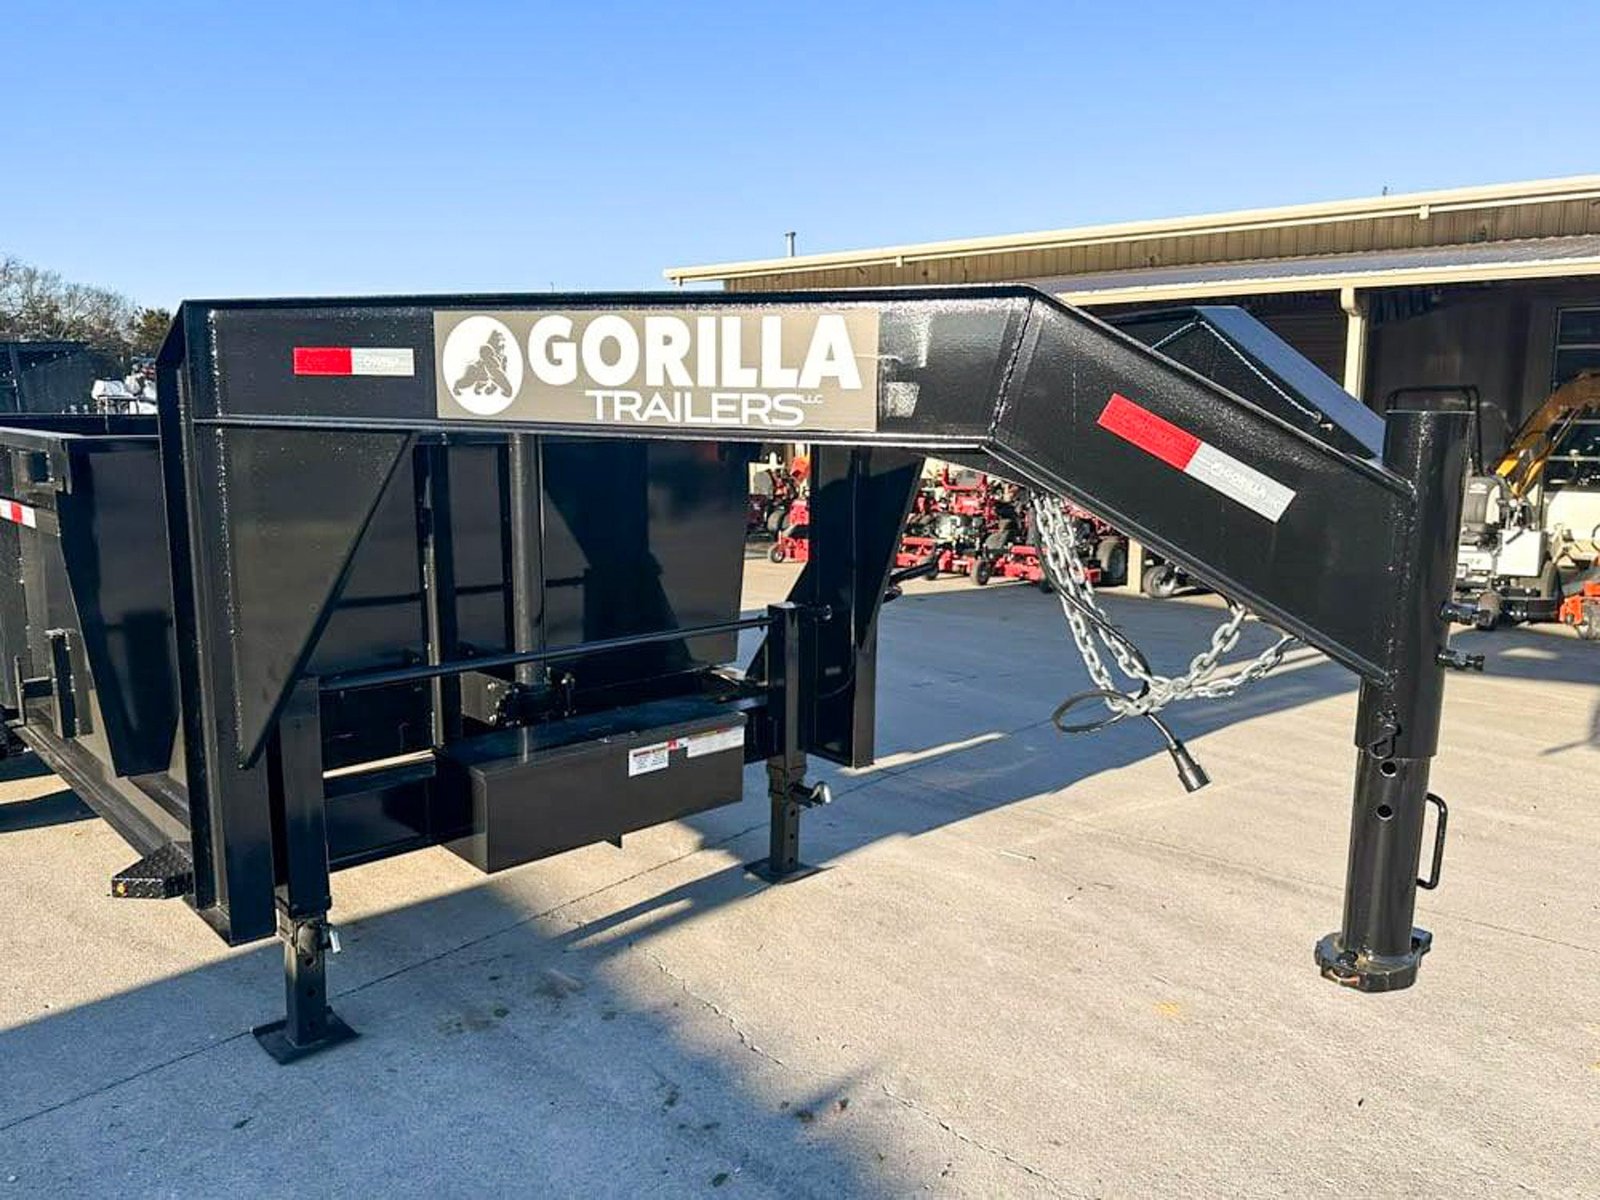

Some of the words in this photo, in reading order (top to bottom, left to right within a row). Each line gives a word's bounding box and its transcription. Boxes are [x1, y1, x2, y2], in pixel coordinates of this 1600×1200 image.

[528, 314, 862, 390] GORILLA
[585, 389, 804, 427] TRAILERS
[801, 394, 824, 404] LLC
